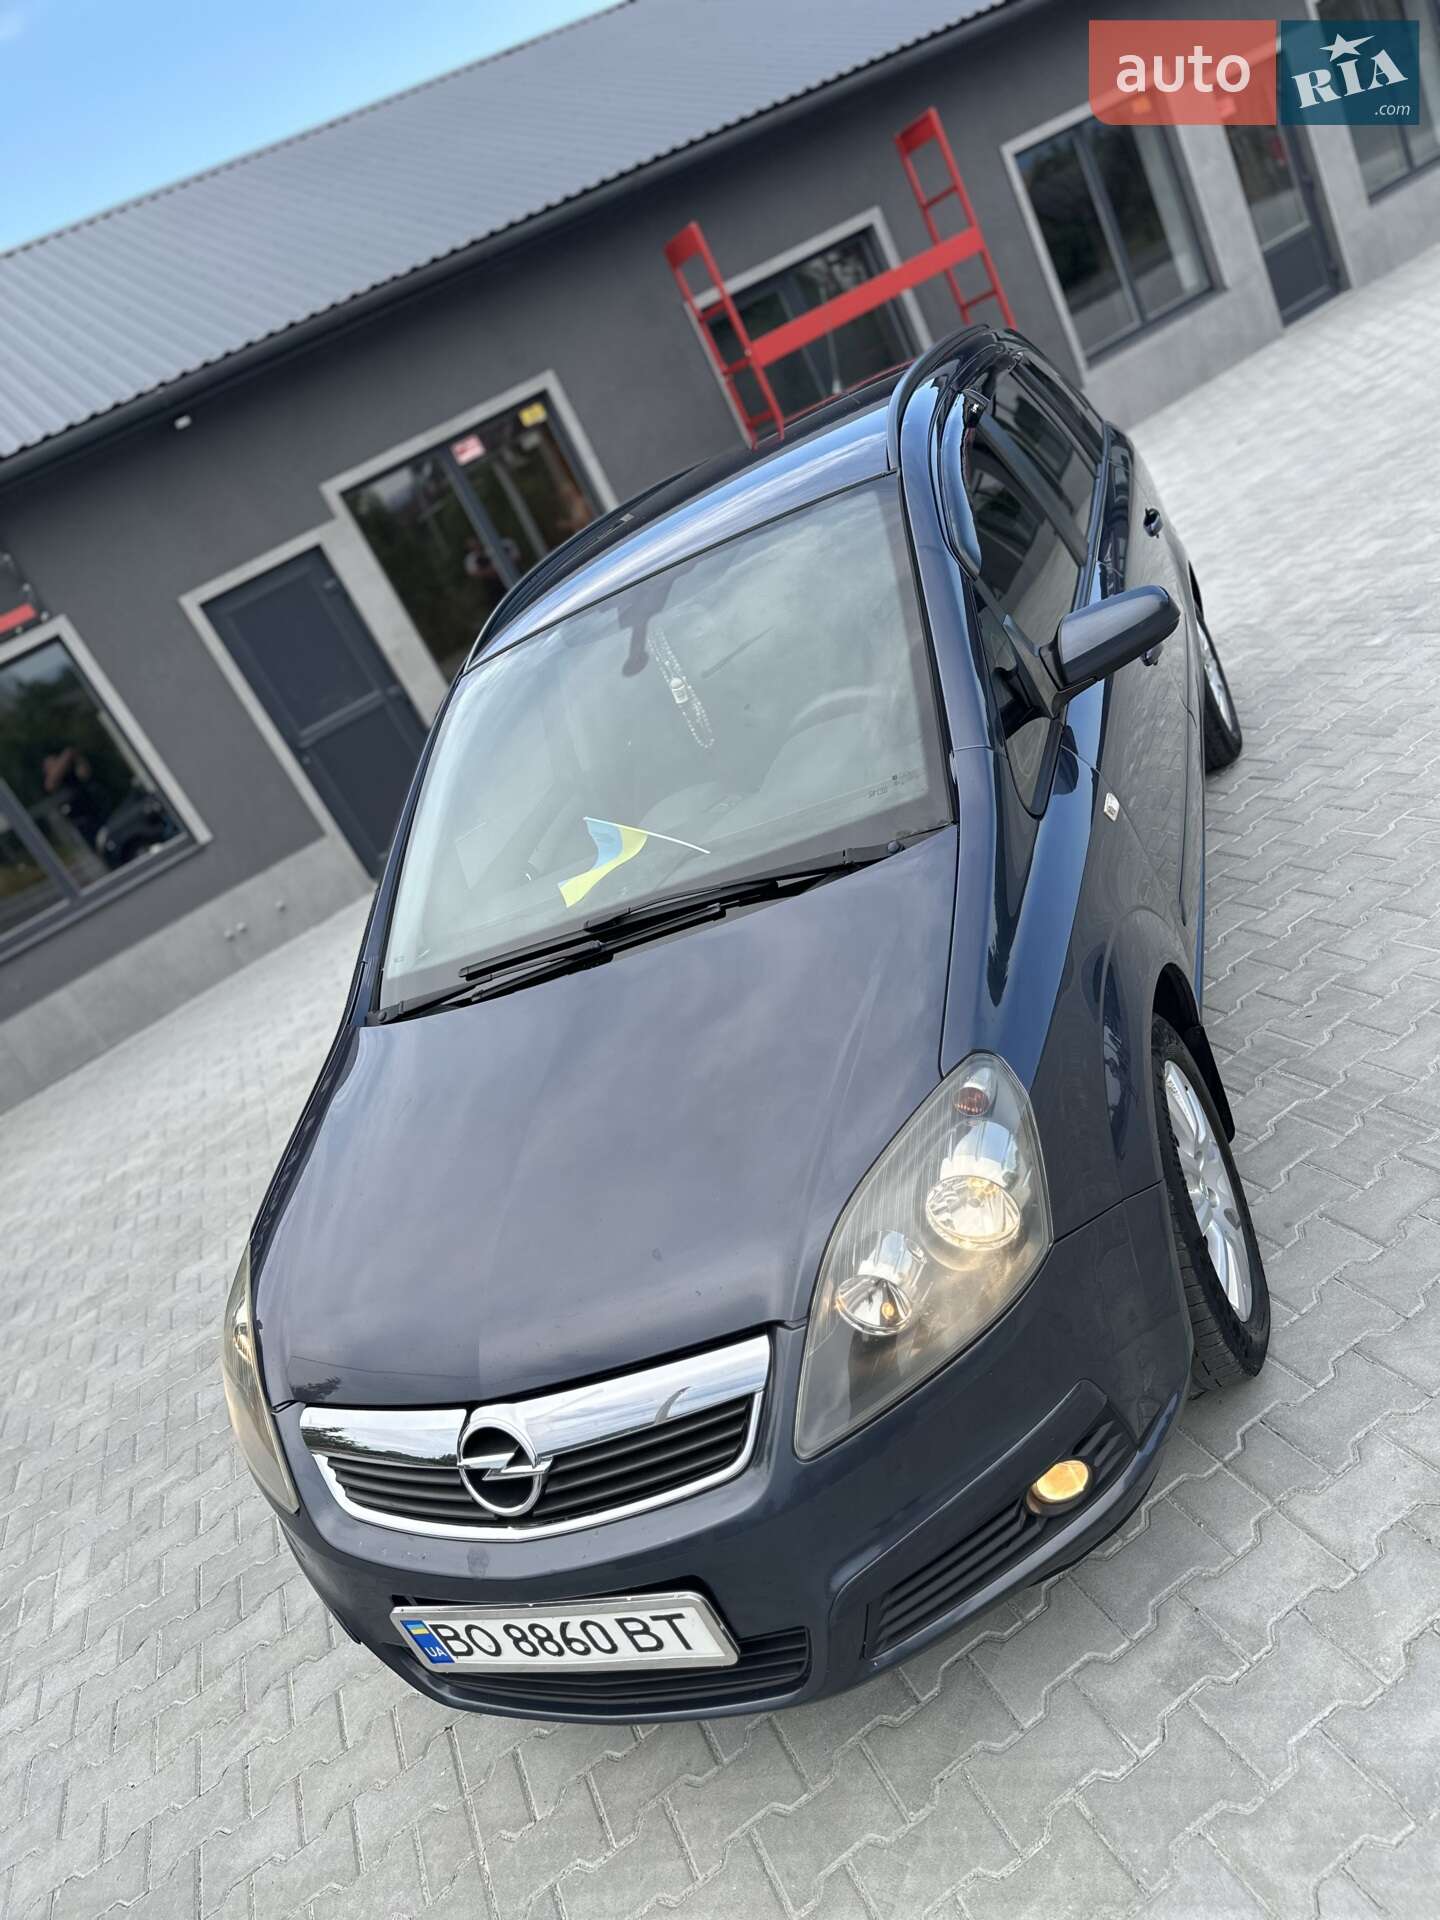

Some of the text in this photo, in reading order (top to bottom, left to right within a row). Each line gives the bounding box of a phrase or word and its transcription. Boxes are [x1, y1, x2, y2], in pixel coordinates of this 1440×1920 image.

[428, 1612, 693, 1658] BO 8860 BT
[424, 1646, 447, 1657] UA
